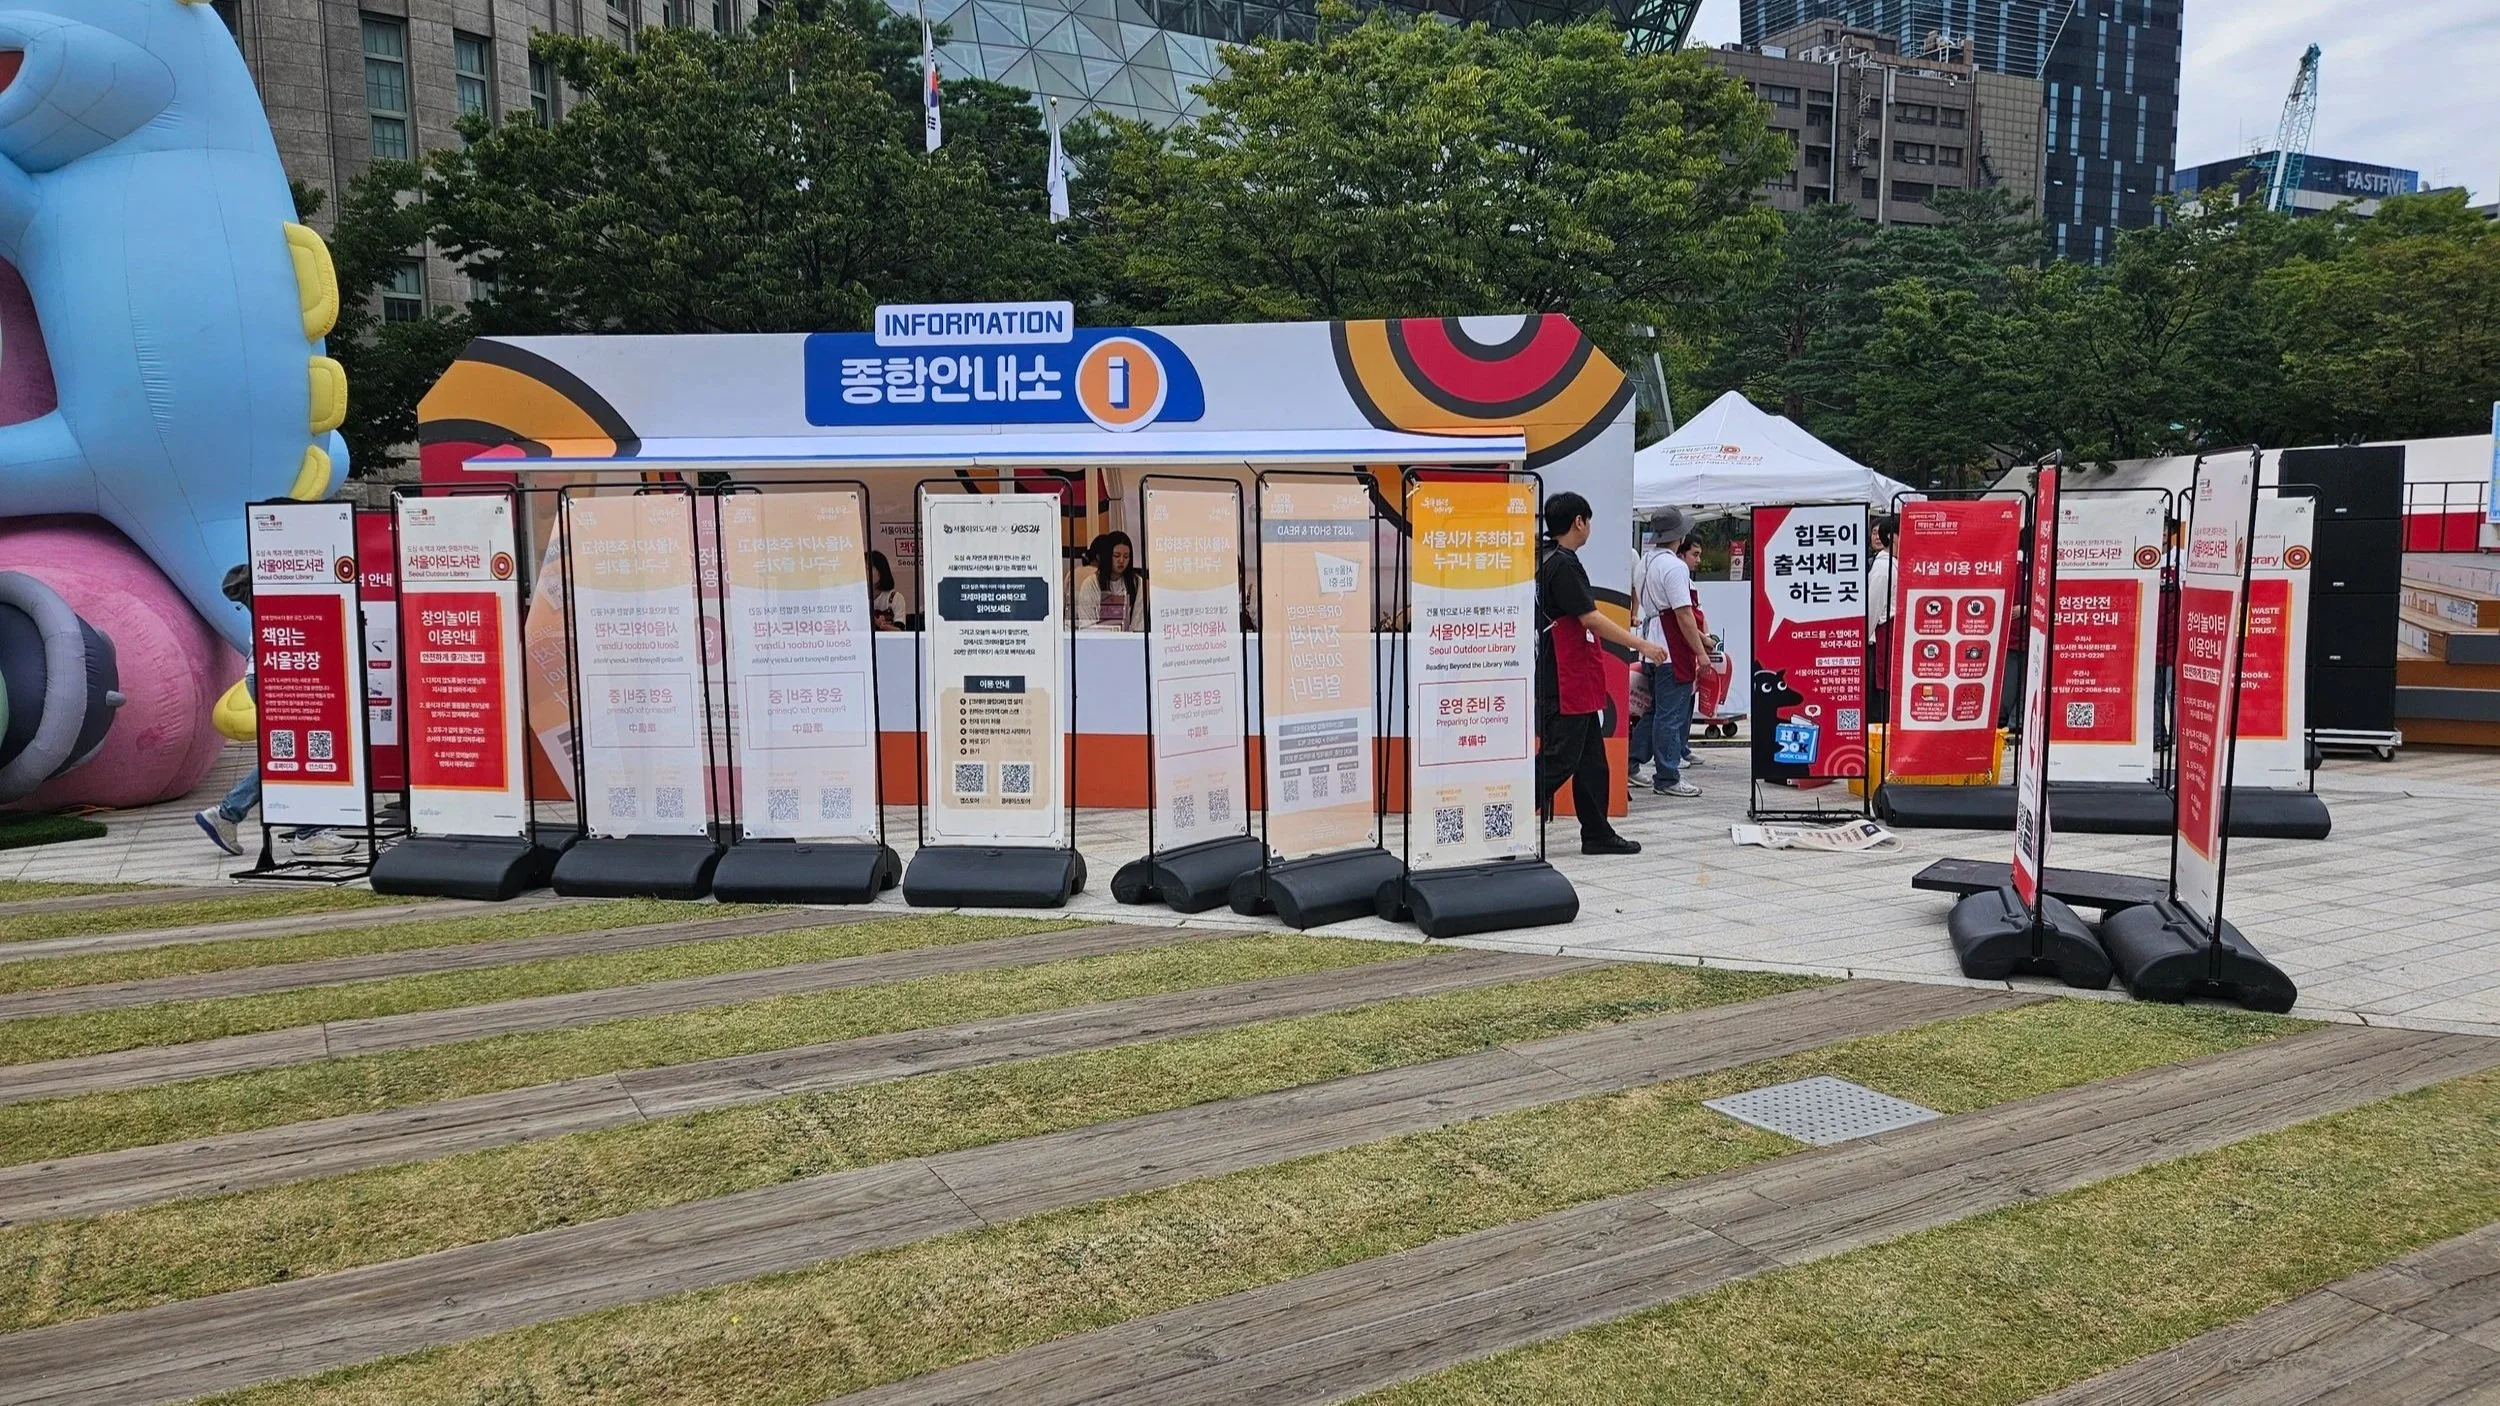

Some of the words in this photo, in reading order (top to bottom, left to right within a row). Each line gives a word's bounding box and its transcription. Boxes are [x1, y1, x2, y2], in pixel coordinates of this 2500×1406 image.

[884, 310, 1063, 336] INFORMATION
[841, 354, 1062, 404] 종합안내소
[954, 525, 997, 533] 서울야외도서관
[1011, 524, 1040, 534] yes24
[1794, 523, 1858, 547] 힙독이
[1422, 532, 1472, 549] 서울시가
[1476, 531, 1525, 548] 주최하고
[257, 558, 324, 573] 서울야외도서관
[408, 555, 480, 570] 서울야외도서관
[1433, 553, 1471, 571] 누구나
[1475, 553, 1512, 570] 즐기는
[1773, 552, 1859, 576] 출석체크
[1913, 561, 1939, 576] 시설
[1944, 561, 1971, 576] 이용
[1974, 560, 2002, 576] 안내
[368, 573, 392, 588] 안내
[1789, 582, 1832, 603] 하는
[1838, 581, 1859, 602] 곳
[976, 605, 1011, 613] 읽어보세요
[2059, 596, 2111, 610] 현장안전
[422, 610, 480, 626] 창의놀이터
[1426, 608, 1438, 616] 건물
[1440, 608, 1458, 616] 밖으로
[1459, 608, 1472, 616] 나온
[1473, 607, 1492, 615] 특별한
[1493, 606, 1506, 615] 독서
[1507, 606, 1520, 615] 공간
[2093, 612, 2119, 626] 안내
[2188, 611, 2226, 636] 창의놀이터
[262, 628, 306, 646] 책읽는
[428, 630, 476, 646] 이용안내
[1429, 621, 1516, 641] 서울야외도서관
[1791, 630, 1826, 639] QR코드를
[1429, 646, 1452, 656] Seoul
[1454, 644, 1486, 654] Outdoor
[1488, 644, 1516, 655] Library
[1820, 640, 1862, 648] 보여주세요!
[2188, 636, 2222, 659] 이용안내
[264, 652, 320, 670] 서울광장
[1426, 664, 1449, 672] Reading
[1450, 662, 1471, 670] Beyond
[1483, 661, 1503, 670] Library
[980, 680, 994, 689] 이용
[995, 680, 1010, 689] 안내
[2241, 680, 2260, 690] city.
[1439, 698, 1463, 715] 운영
[1466, 696, 1490, 714] 준비
[1493, 696, 1506, 712] 중
[1436, 718, 1468, 728] Preparing
[1480, 716, 1509, 725] Opening
[1458, 734, 1487, 747] 準備中
[1781, 730, 1810, 742] HIP
